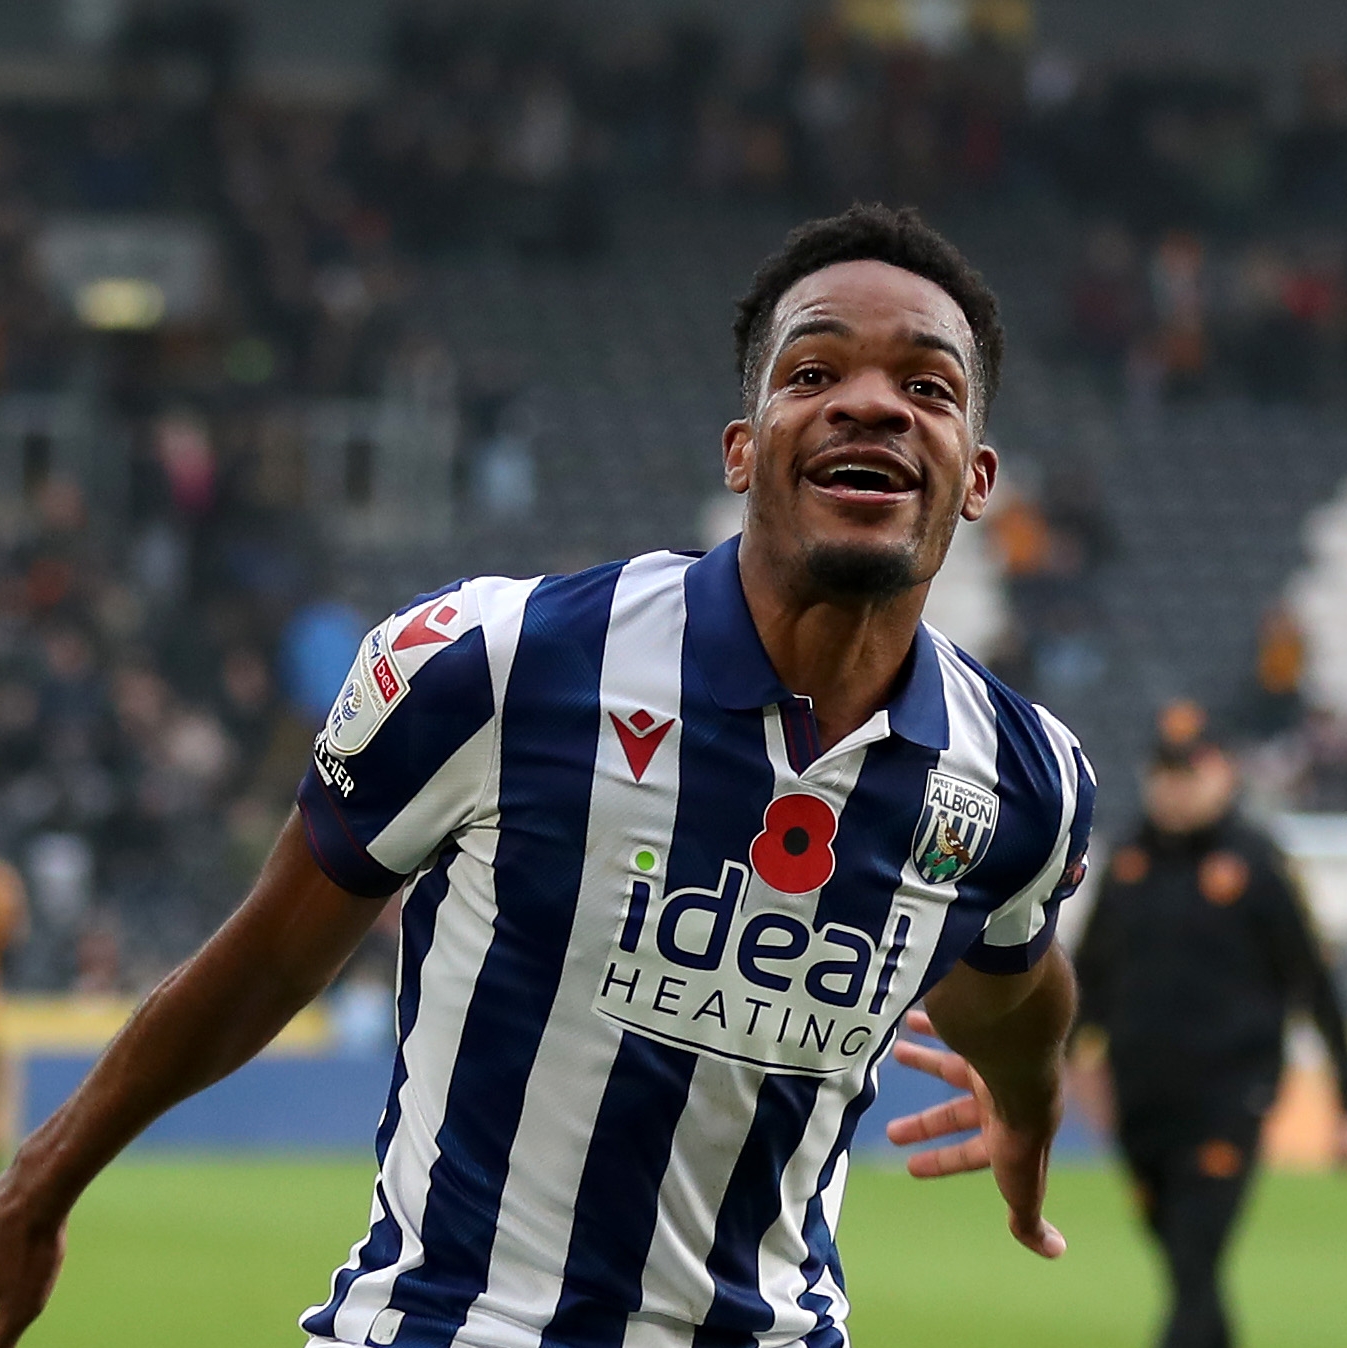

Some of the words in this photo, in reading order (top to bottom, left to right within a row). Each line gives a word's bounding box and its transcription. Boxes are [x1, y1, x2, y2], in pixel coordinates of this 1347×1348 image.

[375, 660, 395, 698] bet
[931, 787, 992, 824] ALBION
[933, 777, 953, 788] WEST
[955, 786, 993, 805] BROMWICH
[619, 850, 911, 1015] ideal
[601, 963, 872, 1057] HEATING
